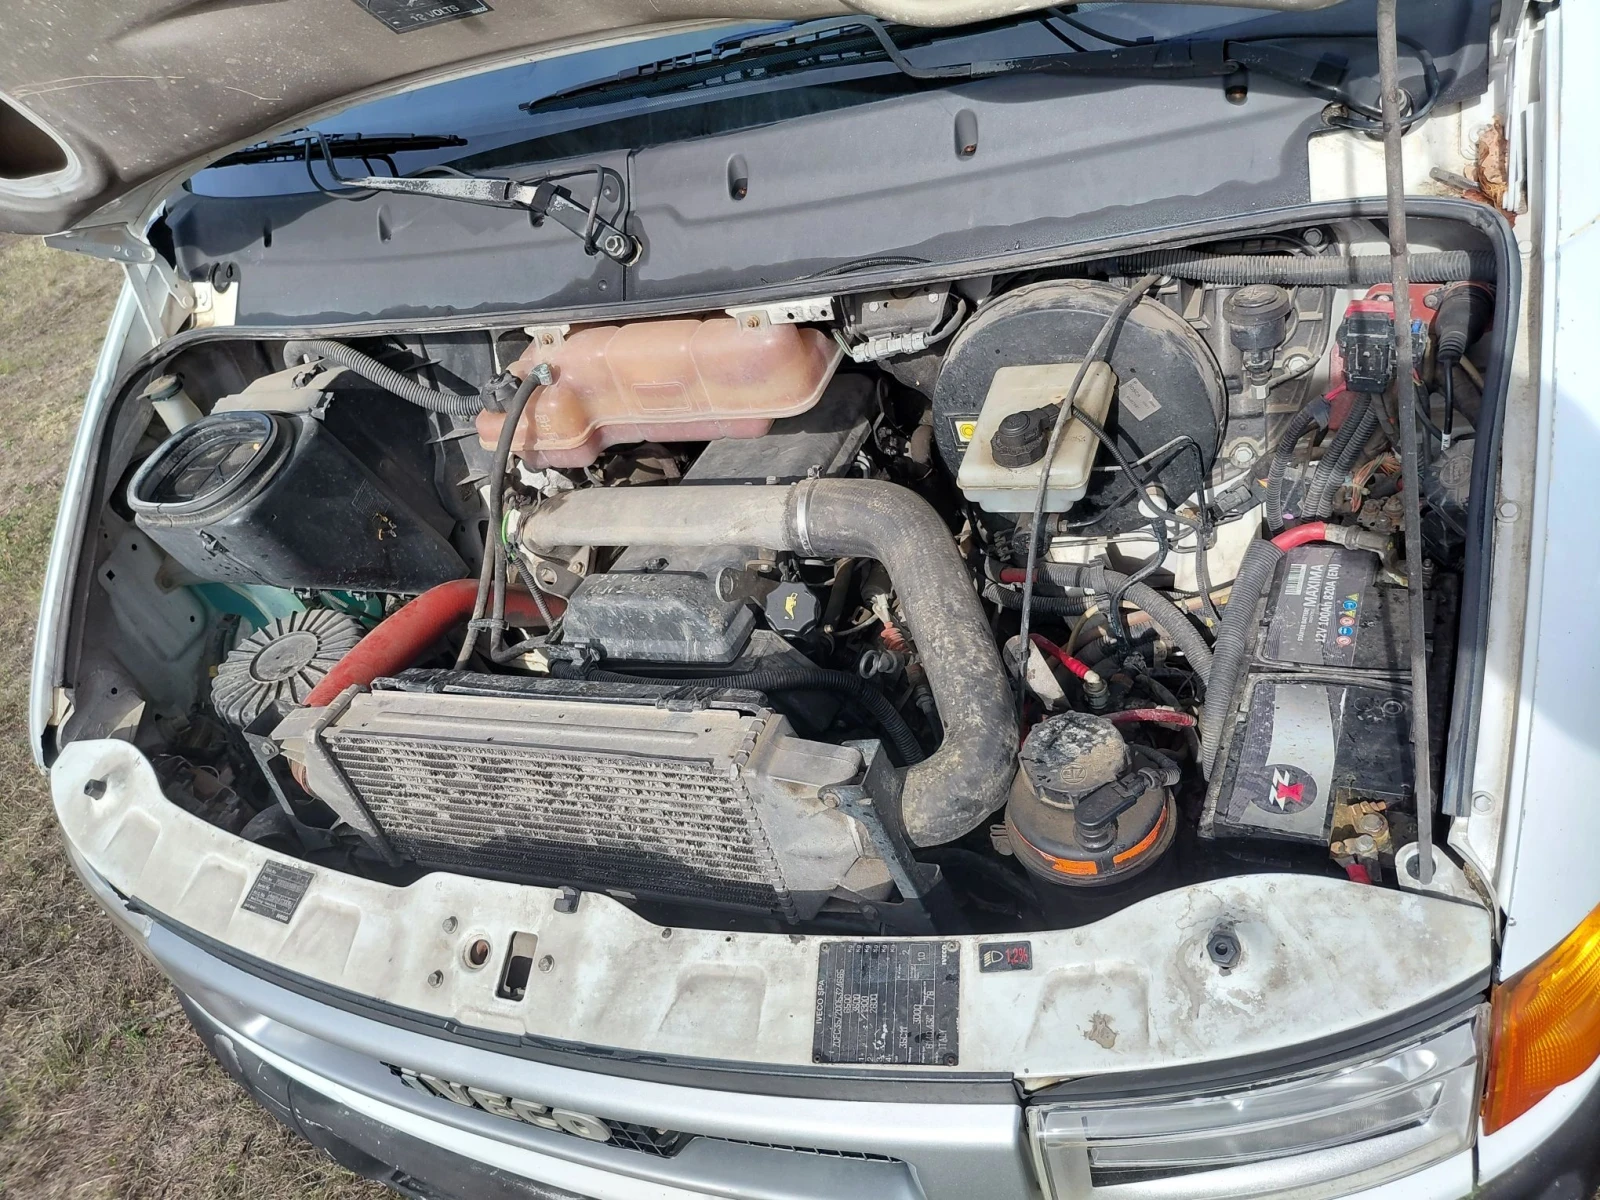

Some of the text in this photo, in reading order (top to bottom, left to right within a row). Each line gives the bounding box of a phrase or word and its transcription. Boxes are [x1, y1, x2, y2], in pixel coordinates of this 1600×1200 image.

[425, 4, 459, 18] VOLTS
[1302, 564, 1324, 607] MAXIMA
[1315, 563, 1342, 643] 12V 100Ah 820A (EN)
[864, 944, 870, 953] Kg
[873, 944, 879, 953] Kg
[881, 944, 888, 953] Kg
[843, 944, 854, 1014] 6500 Kg
[852, 944, 862, 1014] 3500 Kg
[913, 951, 926, 1025] 3000 10
[816, 980, 826, 1024] IVECO SPA
[870, 993, 878, 1014] 2800
[938, 1028, 948, 1050] ITALY
